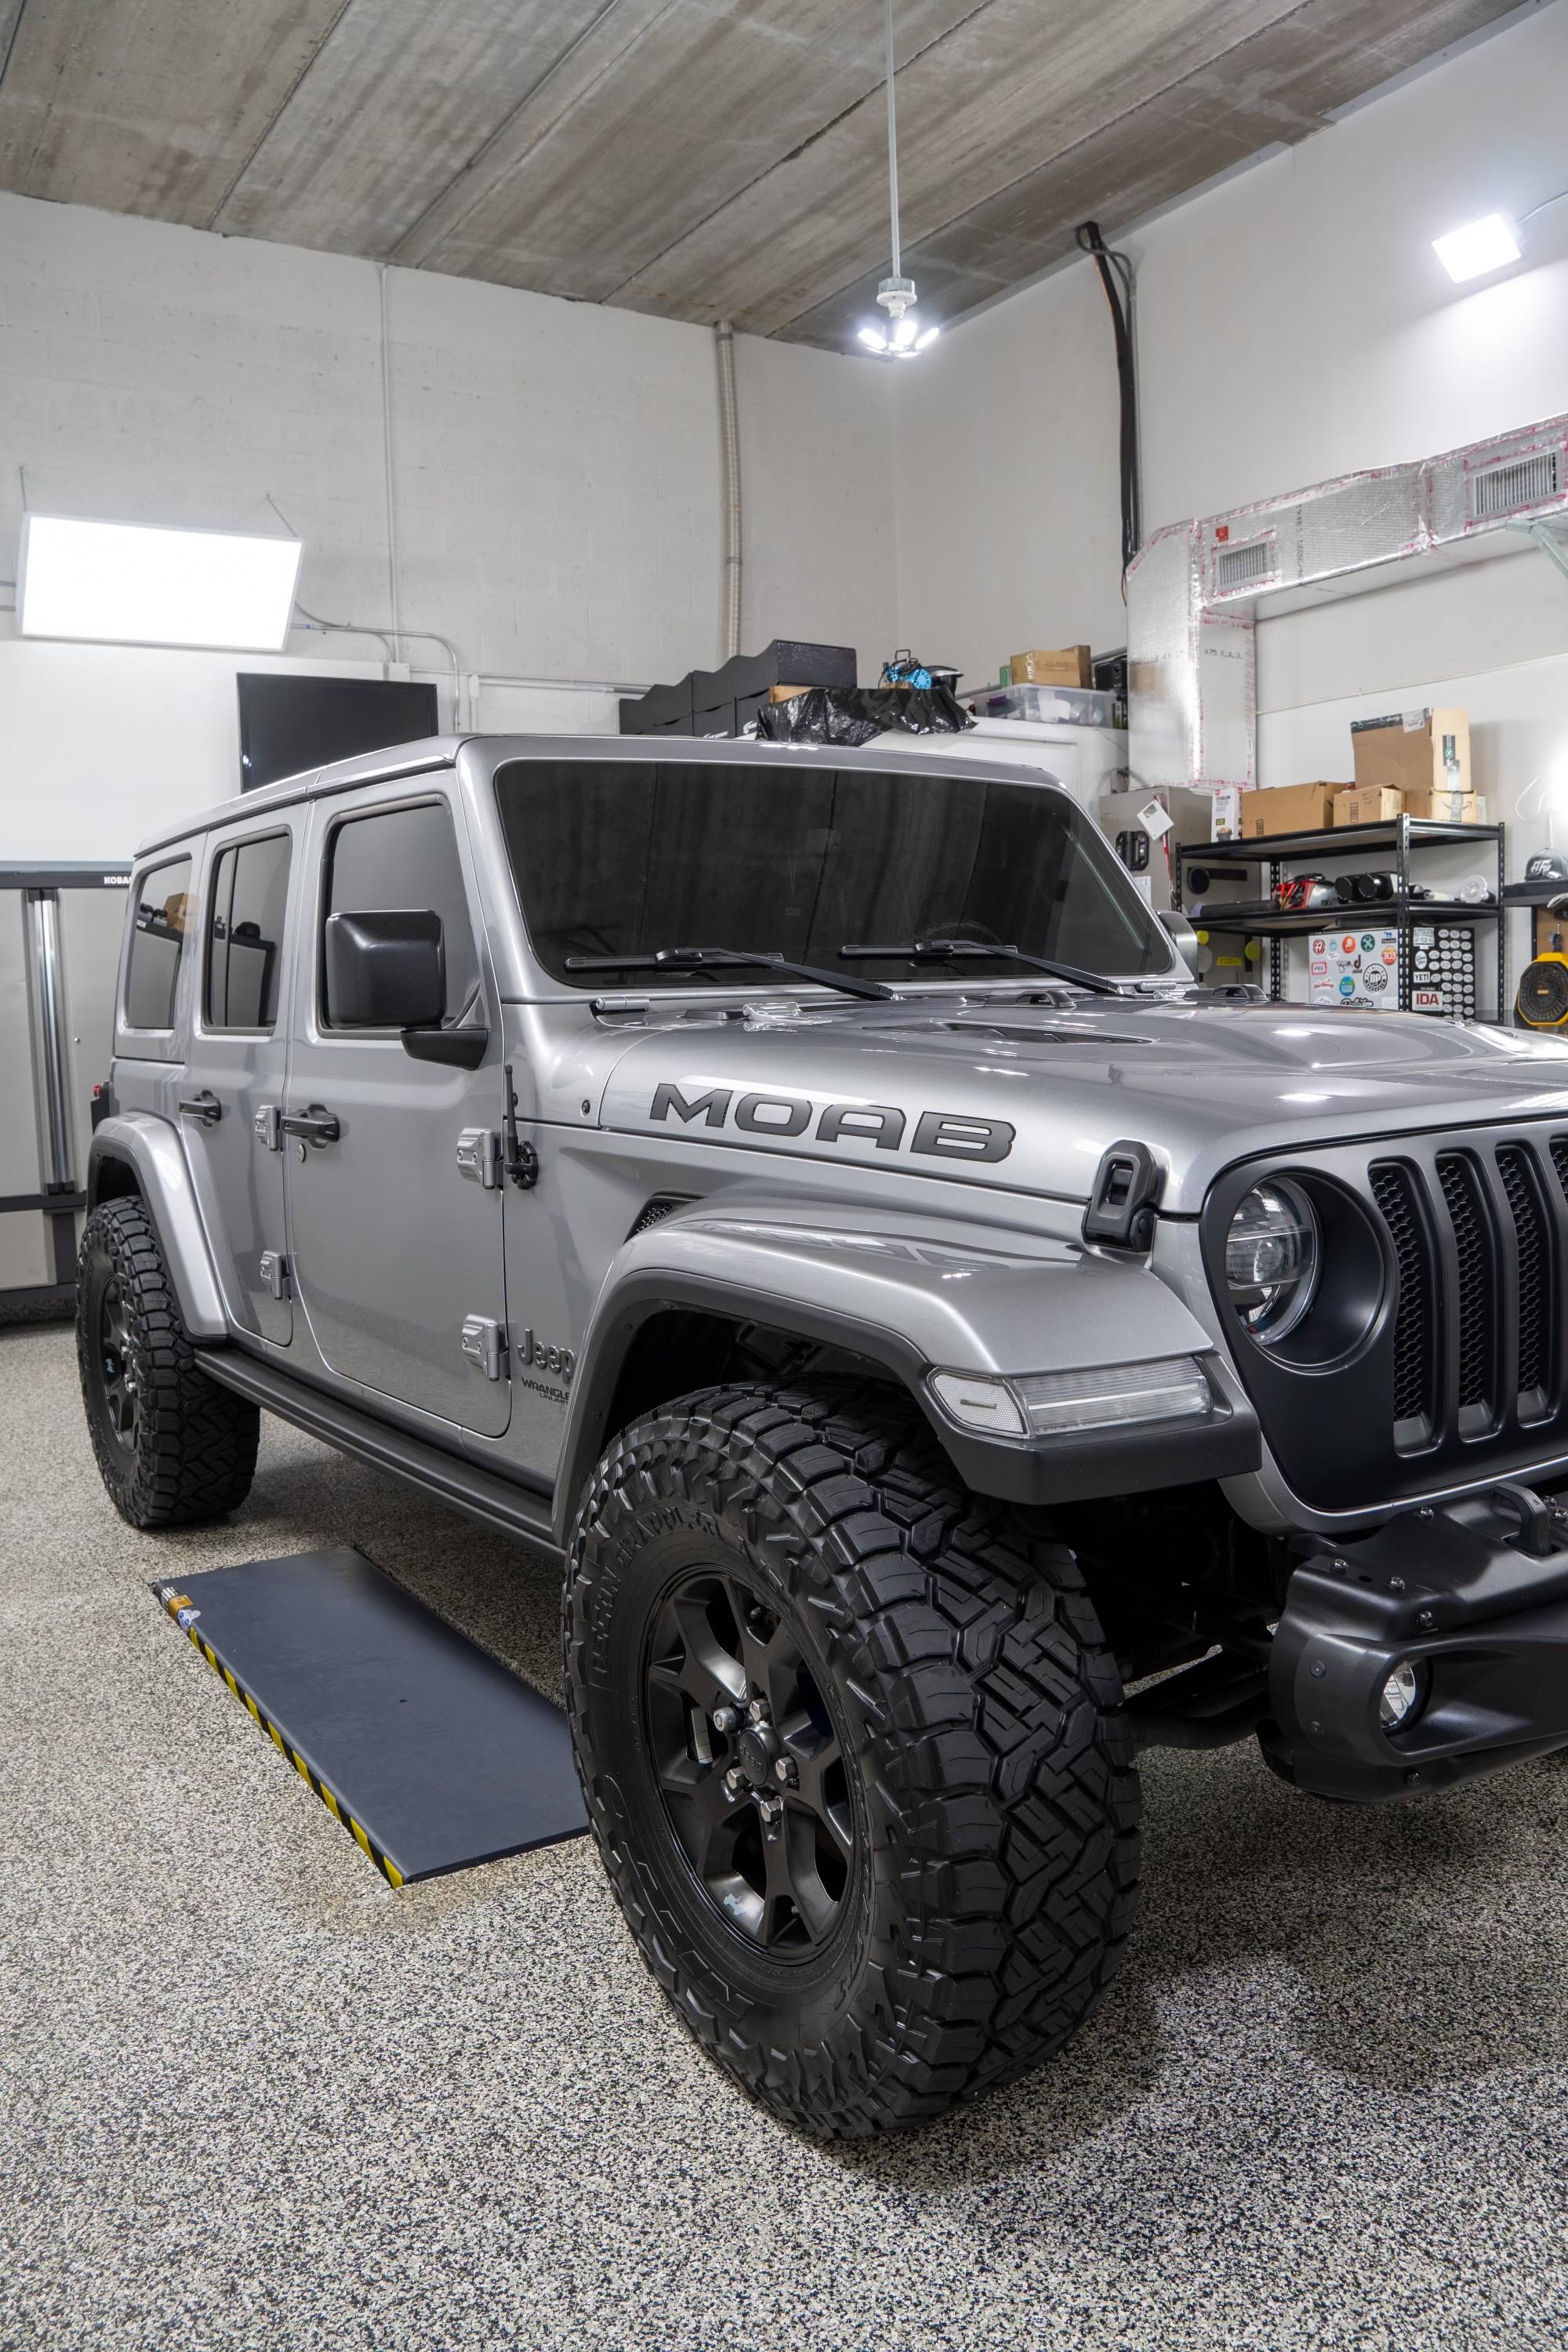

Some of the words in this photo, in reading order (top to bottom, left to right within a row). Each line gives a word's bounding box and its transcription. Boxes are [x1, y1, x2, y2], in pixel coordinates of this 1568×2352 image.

[1381, 951, 1397, 960] 303
[1416, 993, 1439, 1005] IDA
[649, 1083, 1017, 1163] MOAB
[517, 1328, 577, 1385] Jeep
